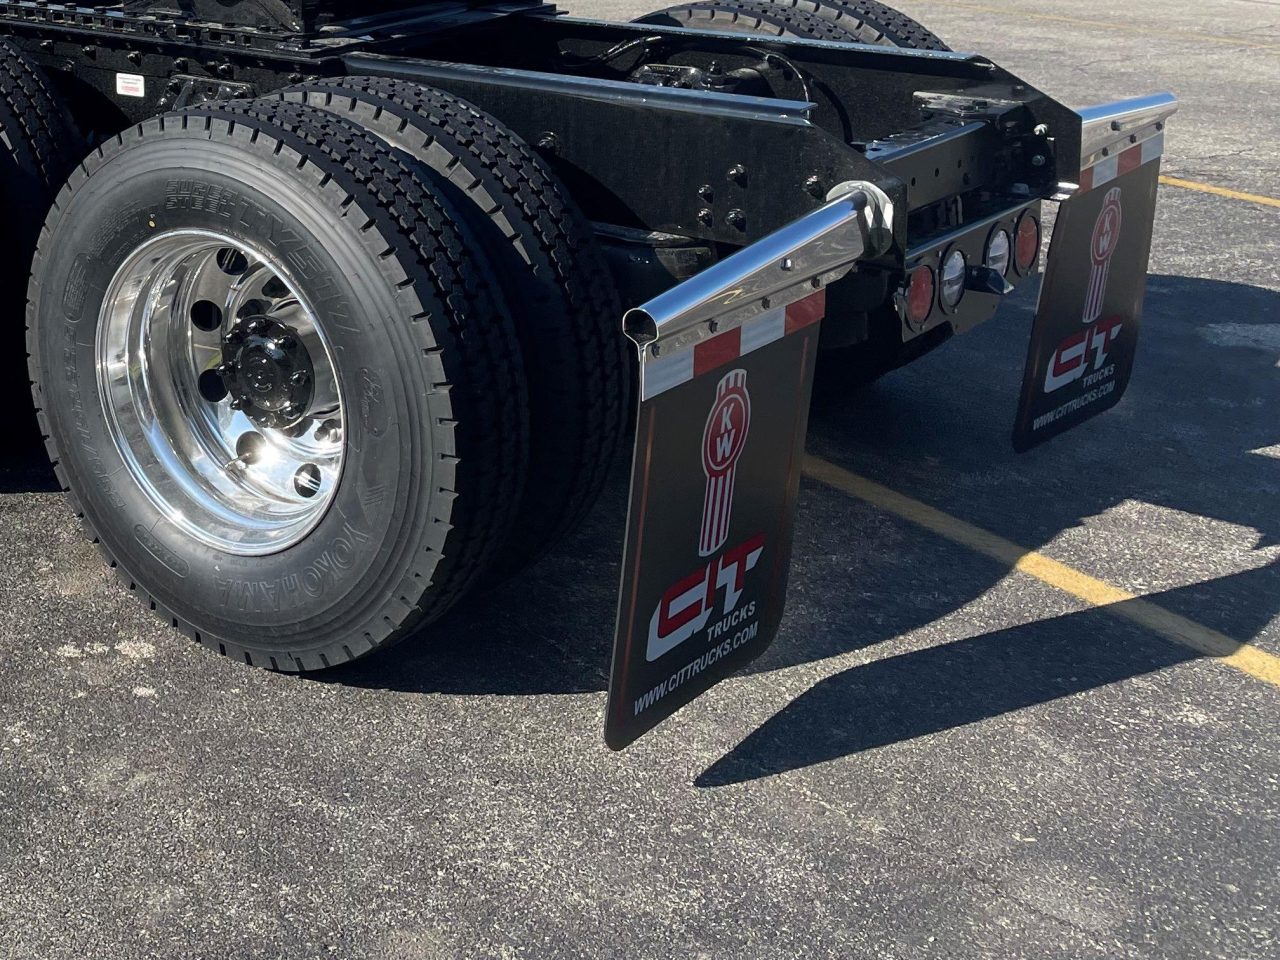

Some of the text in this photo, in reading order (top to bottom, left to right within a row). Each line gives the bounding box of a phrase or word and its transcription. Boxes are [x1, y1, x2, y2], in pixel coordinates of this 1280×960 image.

[1082, 363, 1116, 389] TRUCKS
[1032, 380, 1116, 431] WWW.CITTRUCKS.COM
[215, 522, 369, 612] YOKOHAMA
[707, 601, 756, 643] TRUCKS
[633, 621, 759, 716] WWW.CITTRUCKS.COM
